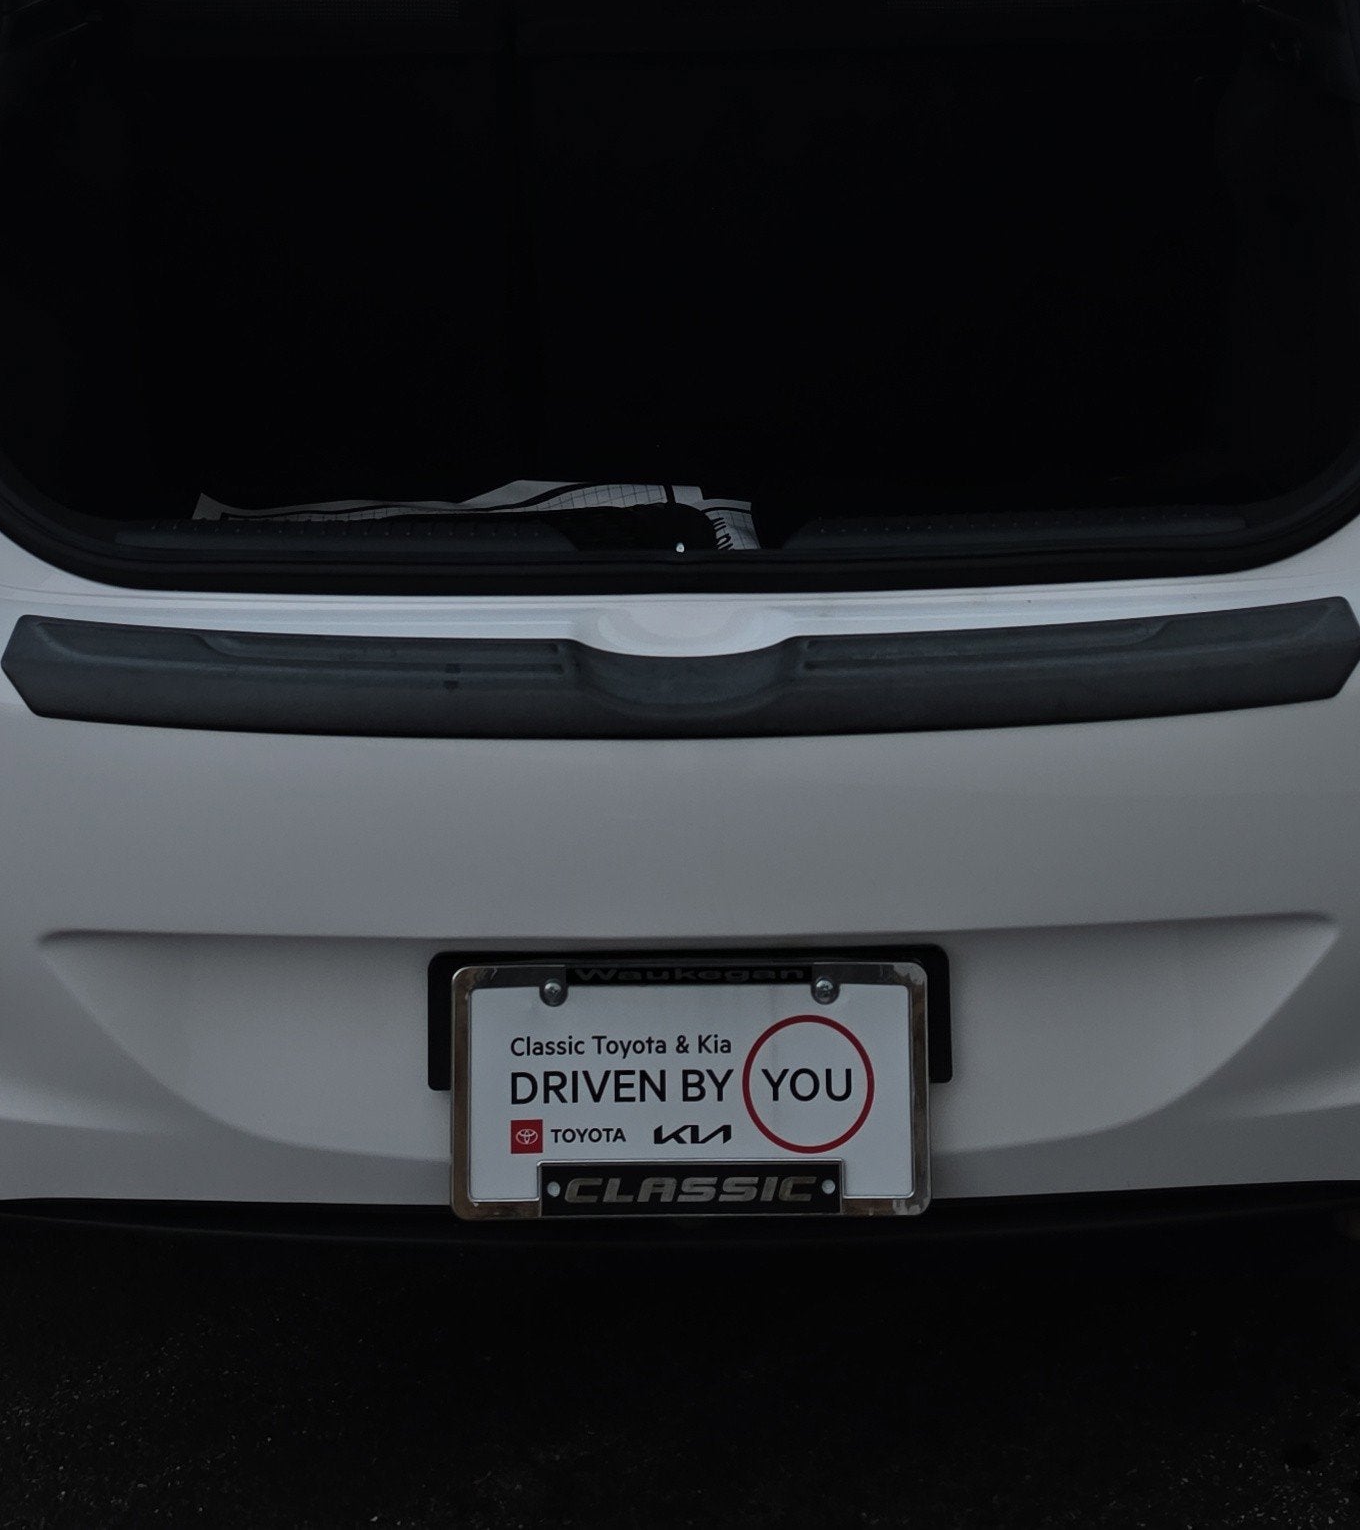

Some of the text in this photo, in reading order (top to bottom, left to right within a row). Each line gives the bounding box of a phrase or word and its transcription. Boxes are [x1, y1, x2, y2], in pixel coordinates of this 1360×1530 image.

[575, 967, 805, 983] Waukegan
[510, 1033, 732, 1060] Classic Toyota & Kia
[510, 1067, 852, 1105] DRIVEN BY YOU
[550, 1127, 627, 1144] TOYOTA
[563, 1175, 818, 1205] CLASSIC
